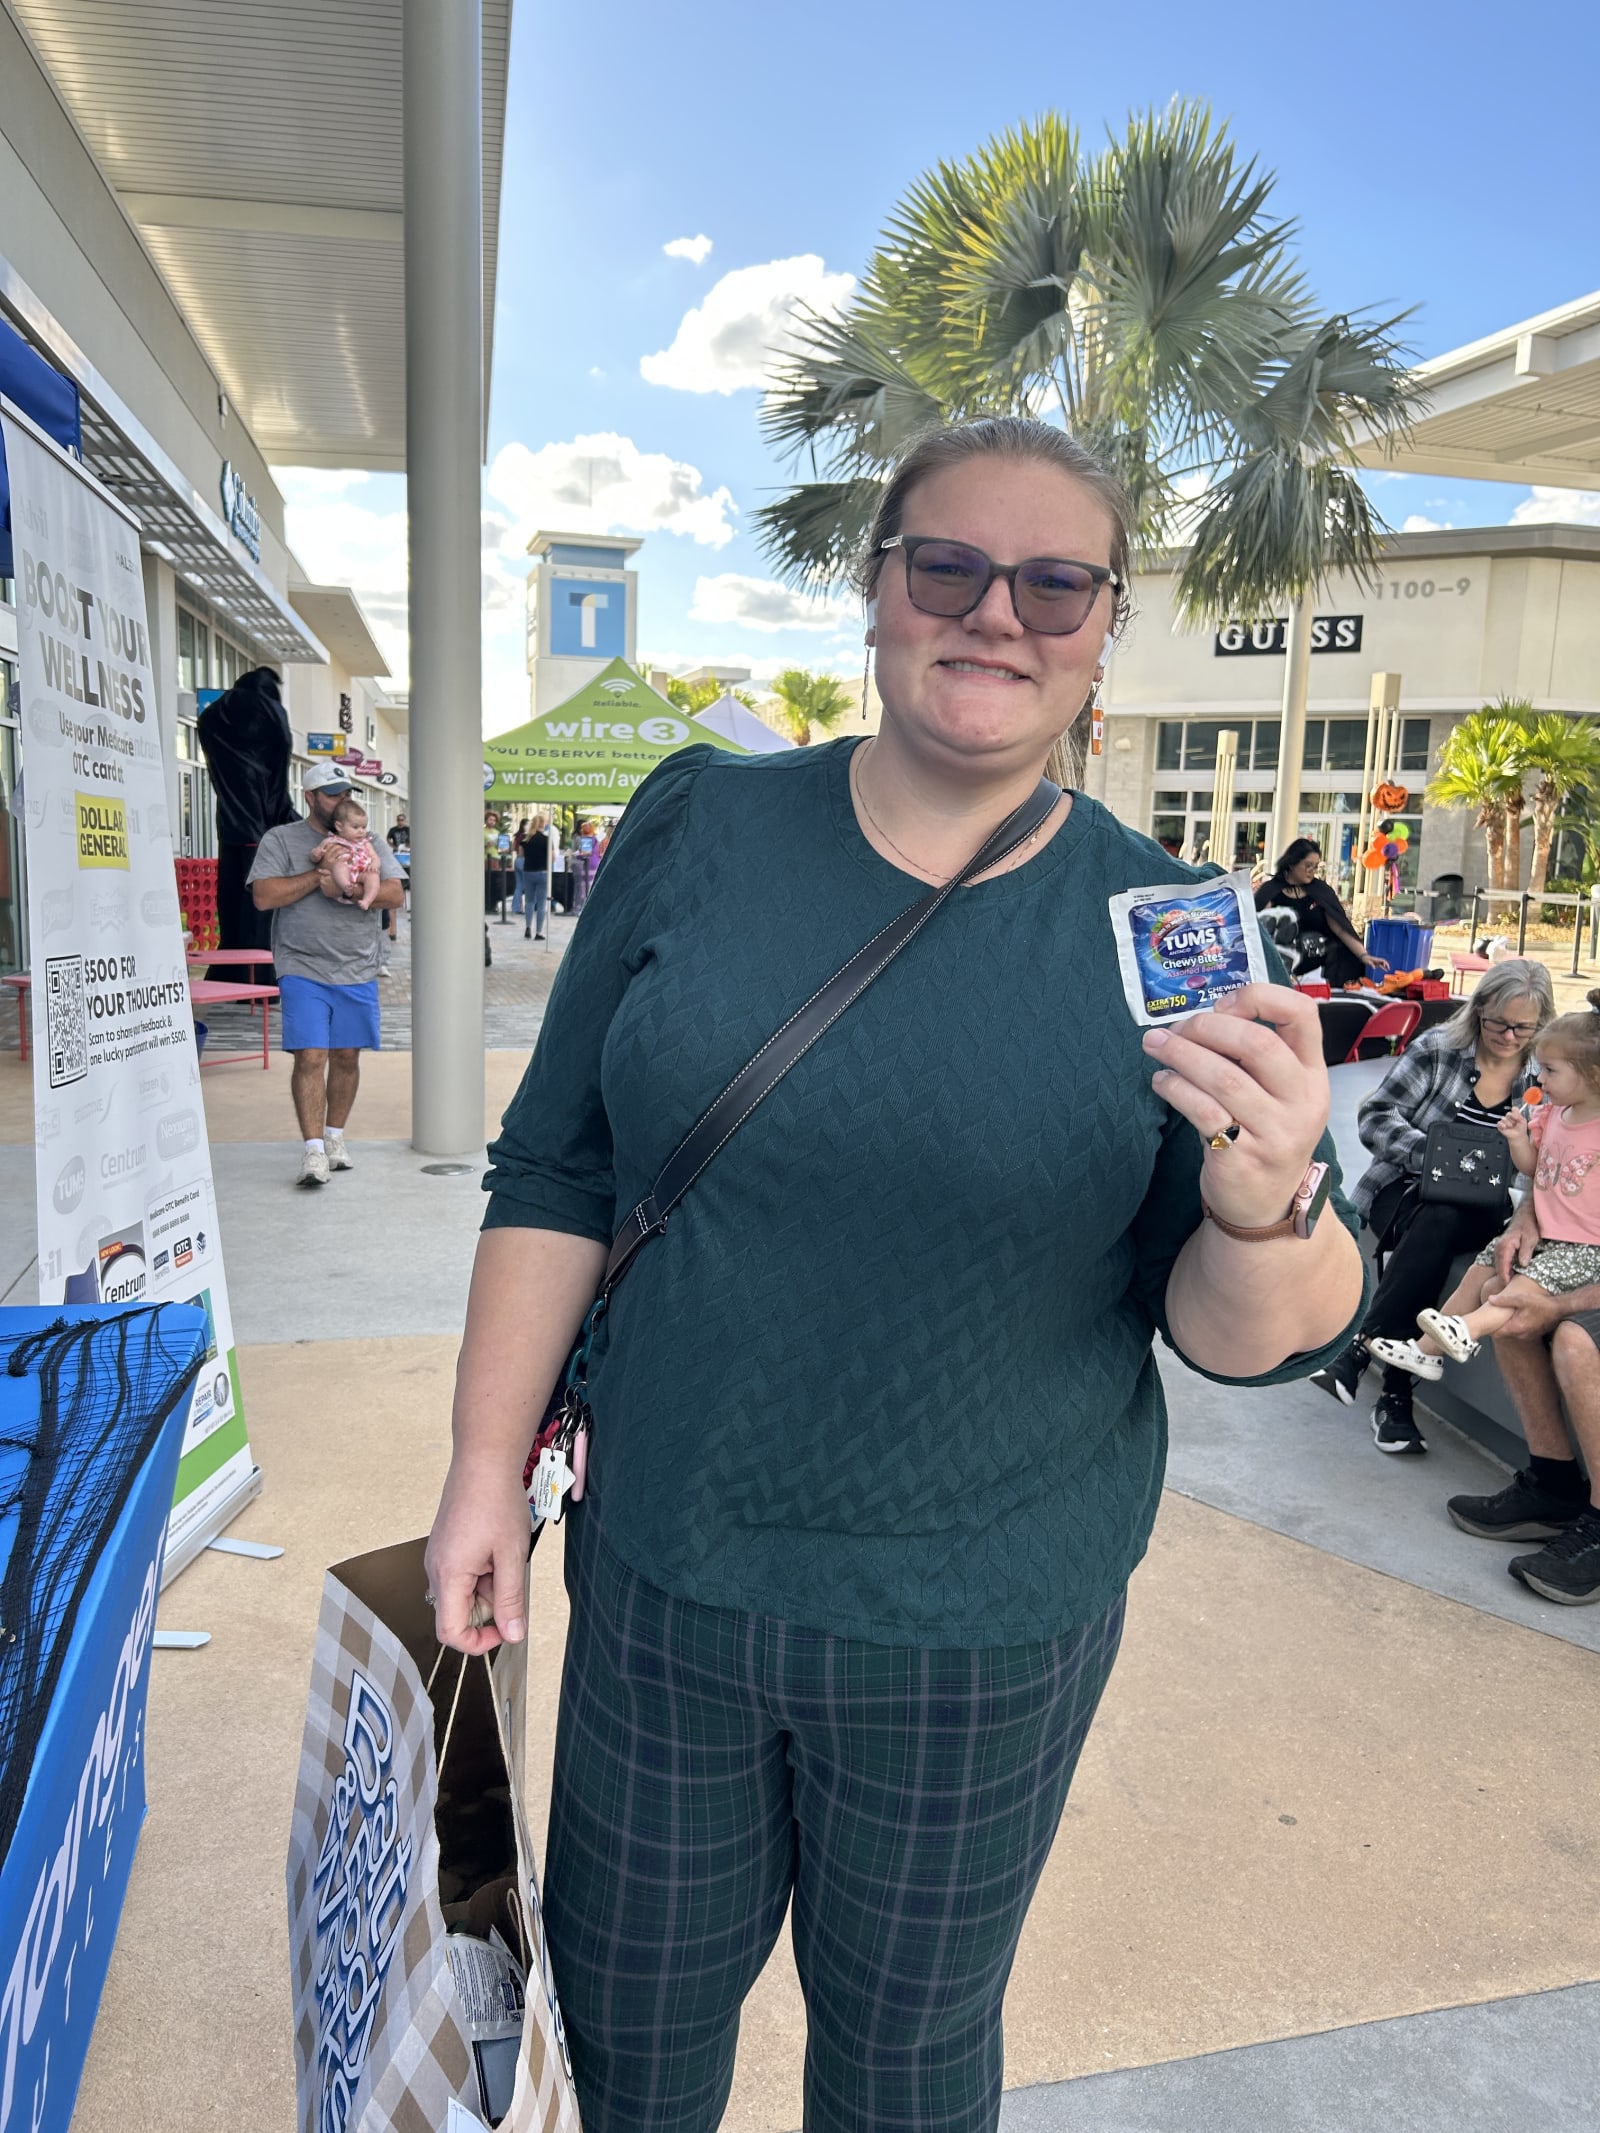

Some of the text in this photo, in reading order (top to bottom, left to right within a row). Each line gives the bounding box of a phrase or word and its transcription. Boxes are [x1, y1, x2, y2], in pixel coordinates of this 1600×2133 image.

[22, 547, 94, 640] BOOST
[96, 596, 151, 670] YOUR
[1218, 618, 1357, 651] GUSS
[39, 630, 146, 724] WELLNESS
[58, 710, 74, 740] Use
[74, 722, 94, 746] your
[97, 724, 135, 757] Medicare
[72, 750, 125, 785] OTC card at
[488, 745, 665, 761] You DESERVE better
[80, 805, 124, 833] DOLLAR
[80, 834, 128, 859] GENERAL
[1163, 928, 1217, 951] TUMS
[85, 955, 137, 986] $500 FOR
[1162, 953, 1224, 970] Chewy Bites
[1167, 966, 1200, 978] Assorted
[86, 981, 184, 1021] YOUR THOUGHTS?
[1147, 994, 1187, 1008] EXTRA 750
[1198, 990, 1207, 1002] 2
[88, 1032, 105, 1047] Scan
[106, 1030, 115, 1042] to
[116, 1025, 134, 1040] share
[140, 1015, 167, 1033] feedback
[167, 1015, 173, 1028] &
[90, 1054, 103, 1066] one
[103, 1046, 124, 1063] lucky
[148, 1034, 159, 1050] will
[159, 1033, 171, 1047] win
[171, 1029, 188, 1046] $500.
[160, 1116, 194, 1139] Nexium
[100, 1143, 147, 1179] Centrum
[57, 1168, 85, 1201] TUMS
[164, 1199, 175, 1213] OTC
[174, 1194, 190, 1209] Benefit
[189, 1188, 200, 1201] Card
[176, 1240, 189, 1255] OTC
[104, 1271, 146, 1304] Centrum
[195, 1389, 212, 1408] REPAIR
[0, 1513, 168, 2133] Tanger
[341, 1814, 382, 2078] Body
[314, 1793, 352, 2133] Works
